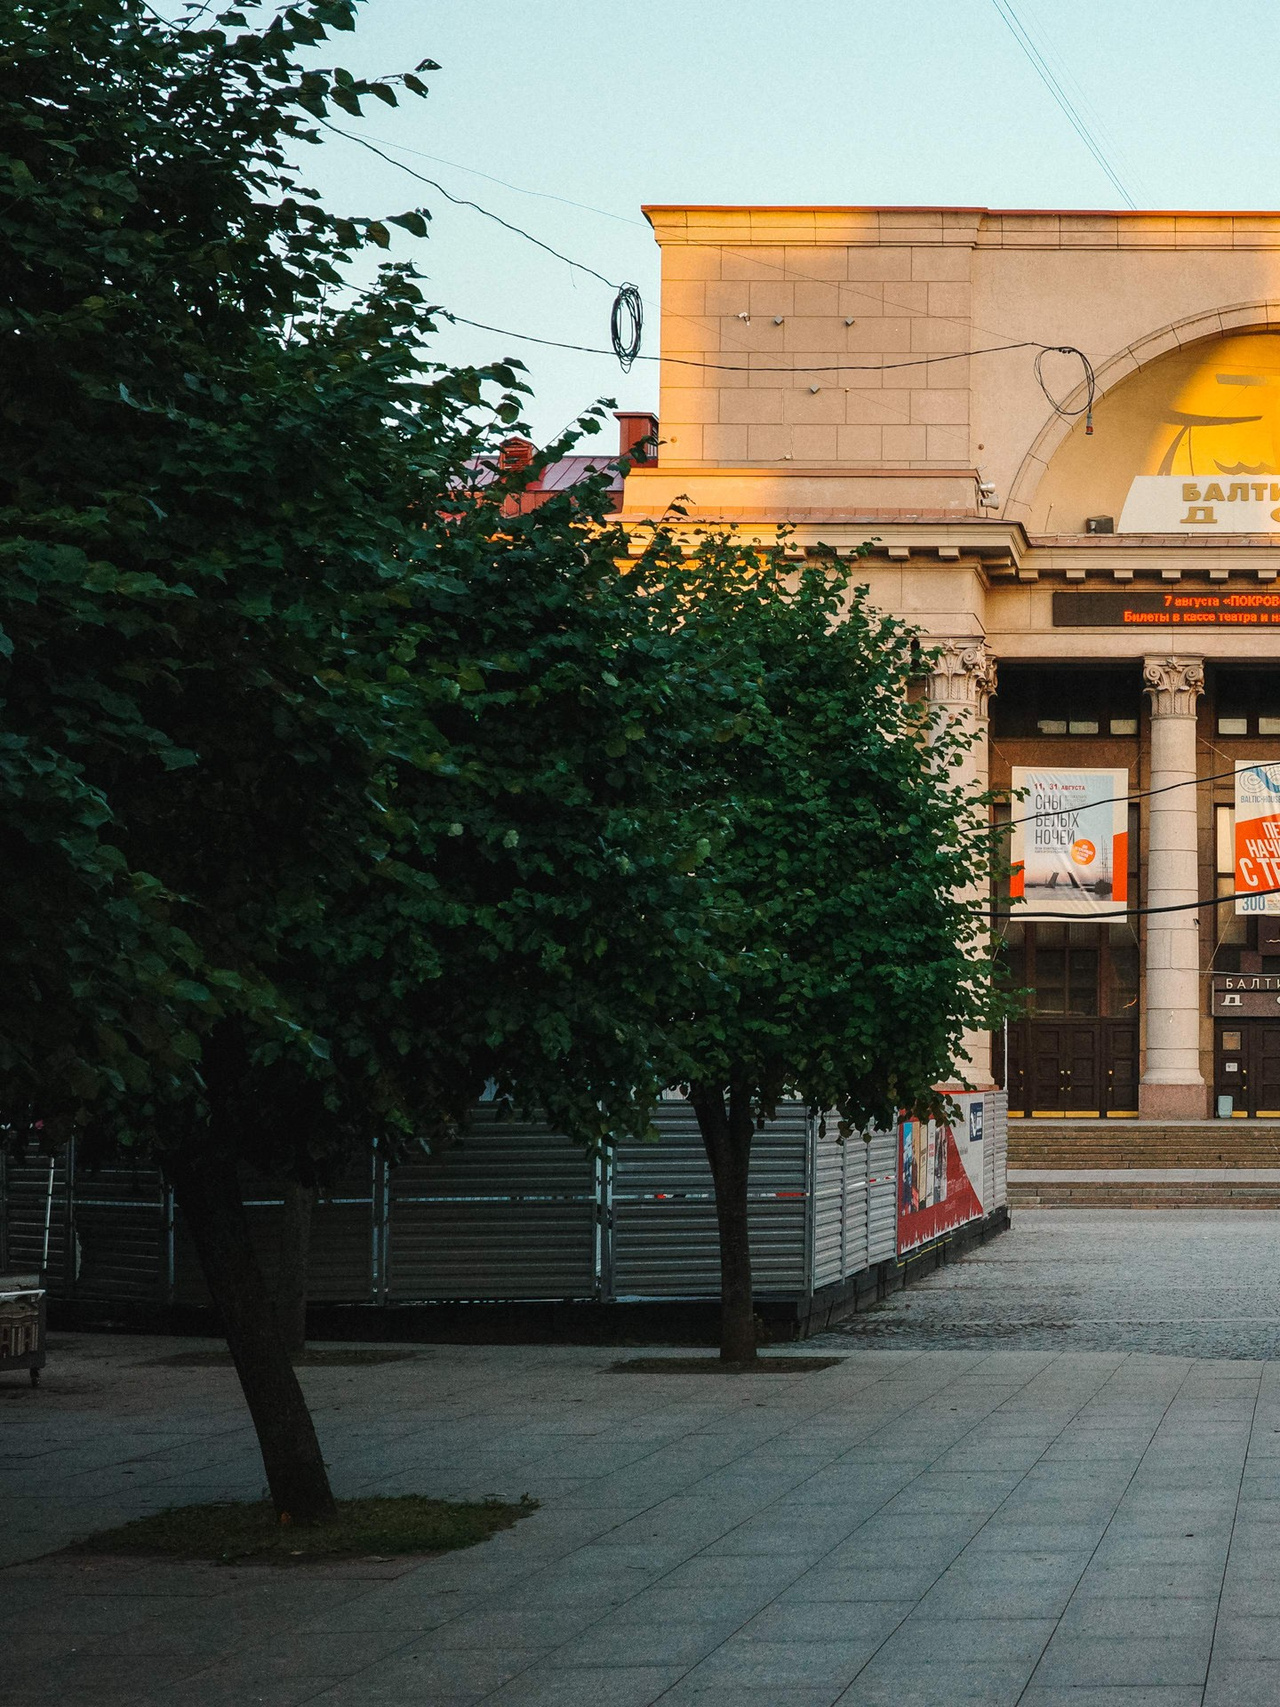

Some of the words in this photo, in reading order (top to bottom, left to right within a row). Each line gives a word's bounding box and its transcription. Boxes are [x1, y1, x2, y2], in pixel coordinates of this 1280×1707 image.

[1164, 595, 1173, 607] 7
[1174, 597, 1220, 608] августа
[1123, 611, 1170, 622] Билеты
[1172, 613, 1181, 622] в
[1183, 613, 1216, 622] кассе
[1218, 613, 1258, 623] театра
[1260, 613, 1269, 622] и
[1035, 794, 1062, 810] СНЫ
[1035, 812, 1080, 828] БЕЛЫХ
[1035, 828, 1075, 845] НОЧЕЙ
[1239, 857, 1259, 887] С
[1242, 894, 1266, 911] 300
